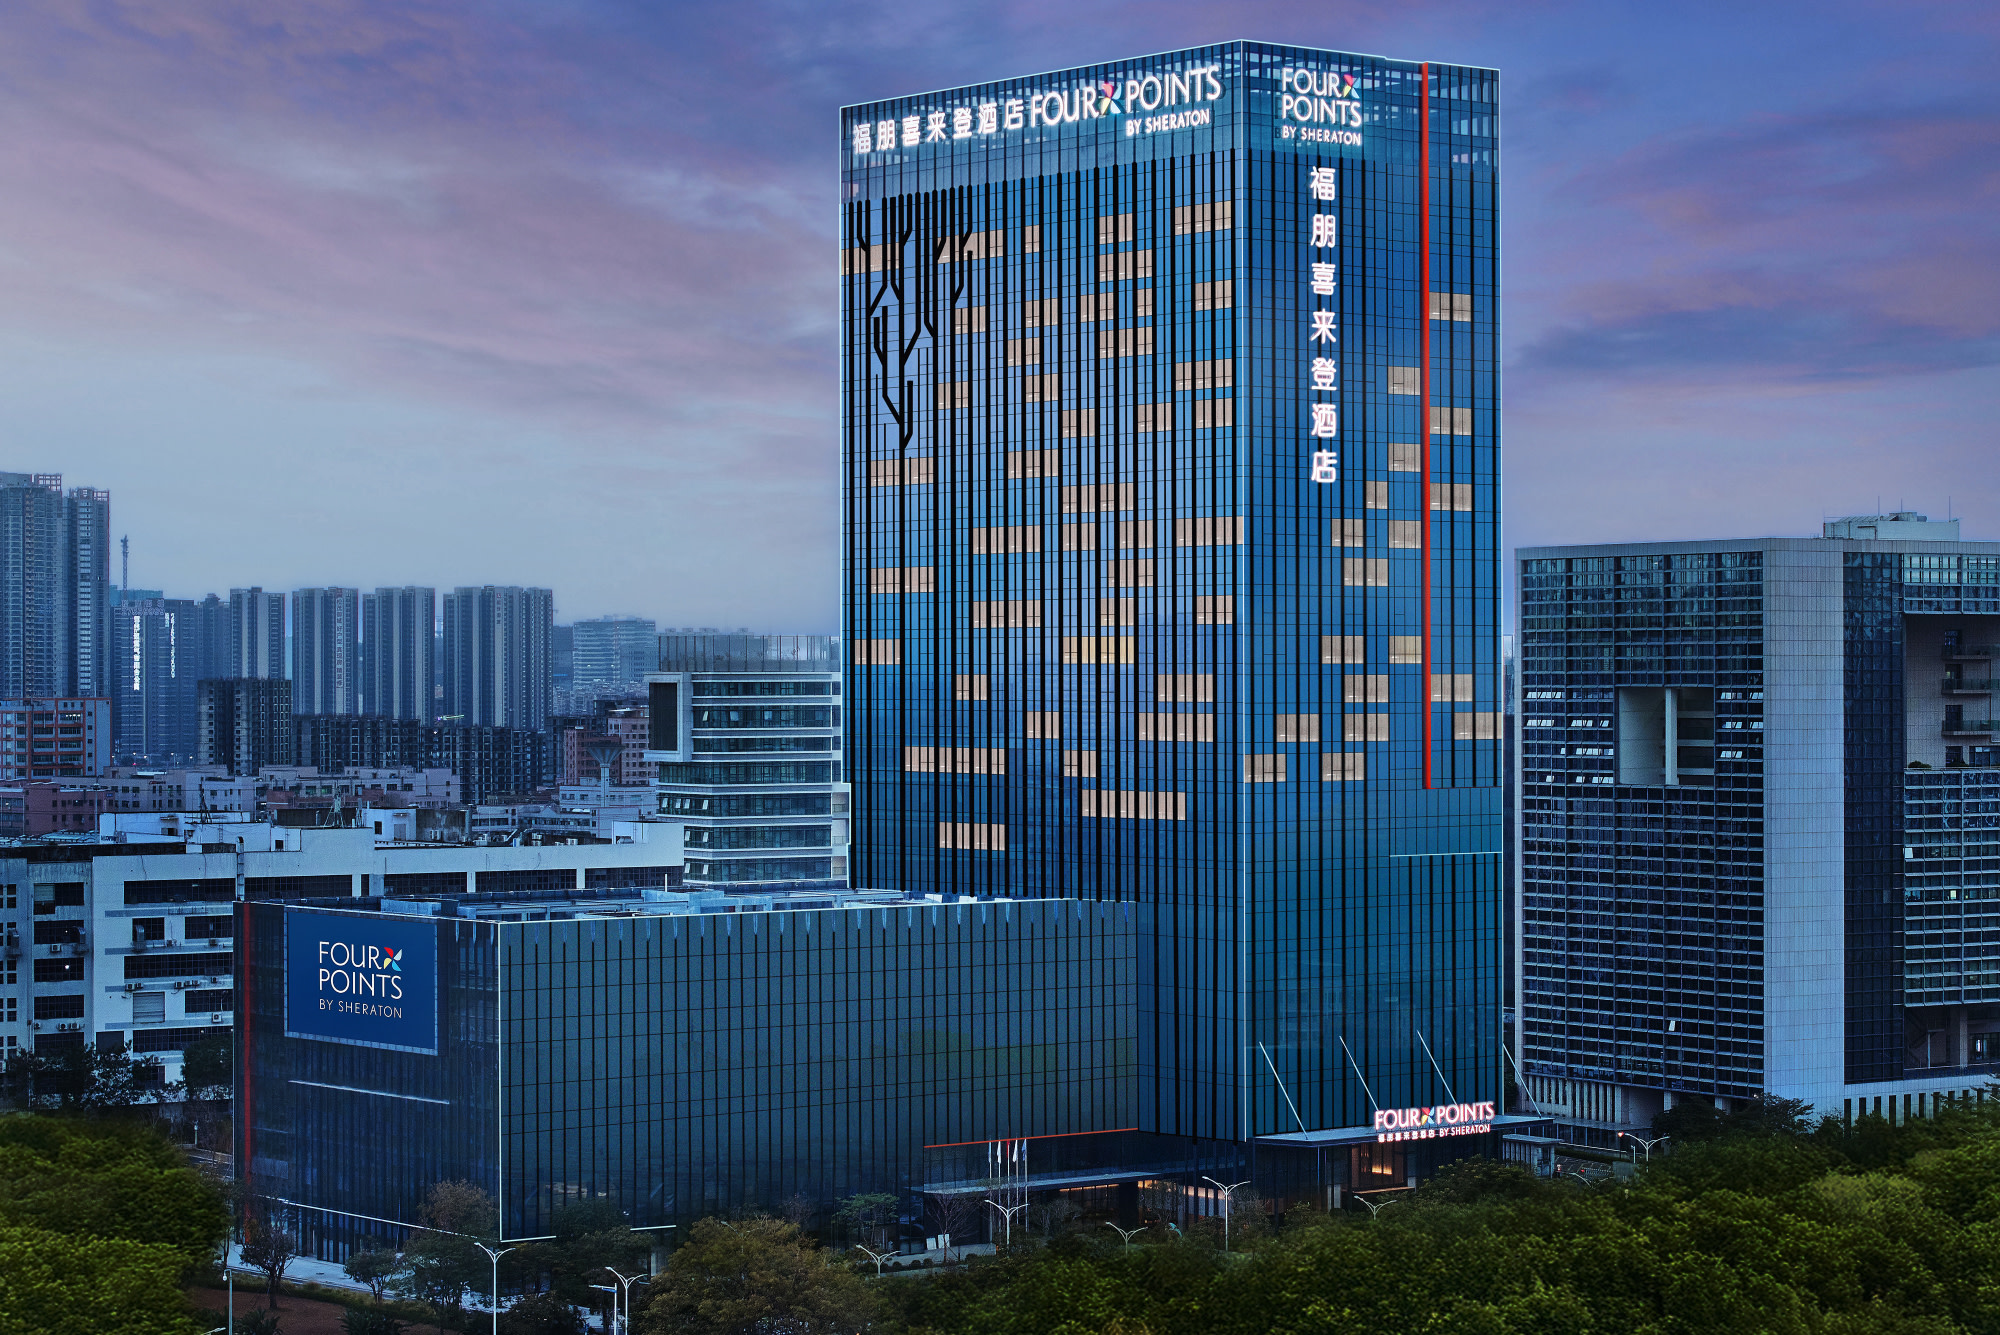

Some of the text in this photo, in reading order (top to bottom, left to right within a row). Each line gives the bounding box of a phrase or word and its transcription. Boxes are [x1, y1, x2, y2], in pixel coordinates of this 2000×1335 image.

[1030, 64, 1222, 128] FOUR POINTS
[1281, 67, 1342, 98] FOUR
[1125, 108, 1211, 137] BY SHERATON
[1281, 94, 1362, 128] POINTS
[852, 98, 1024, 155] 福朋喜来登酒店
[1281, 125, 1362, 146] BY SHERATON
[1310, 165, 1338, 484] 福朋喜来登酒店
[319, 941, 382, 970] FOUR
[319, 968, 403, 1000] POINTS
[319, 998, 402, 1019] BY SHERATON
[1374, 1101, 1495, 1131] FOUR POINTS
[1439, 1123, 1491, 1138] BY SHERATON
